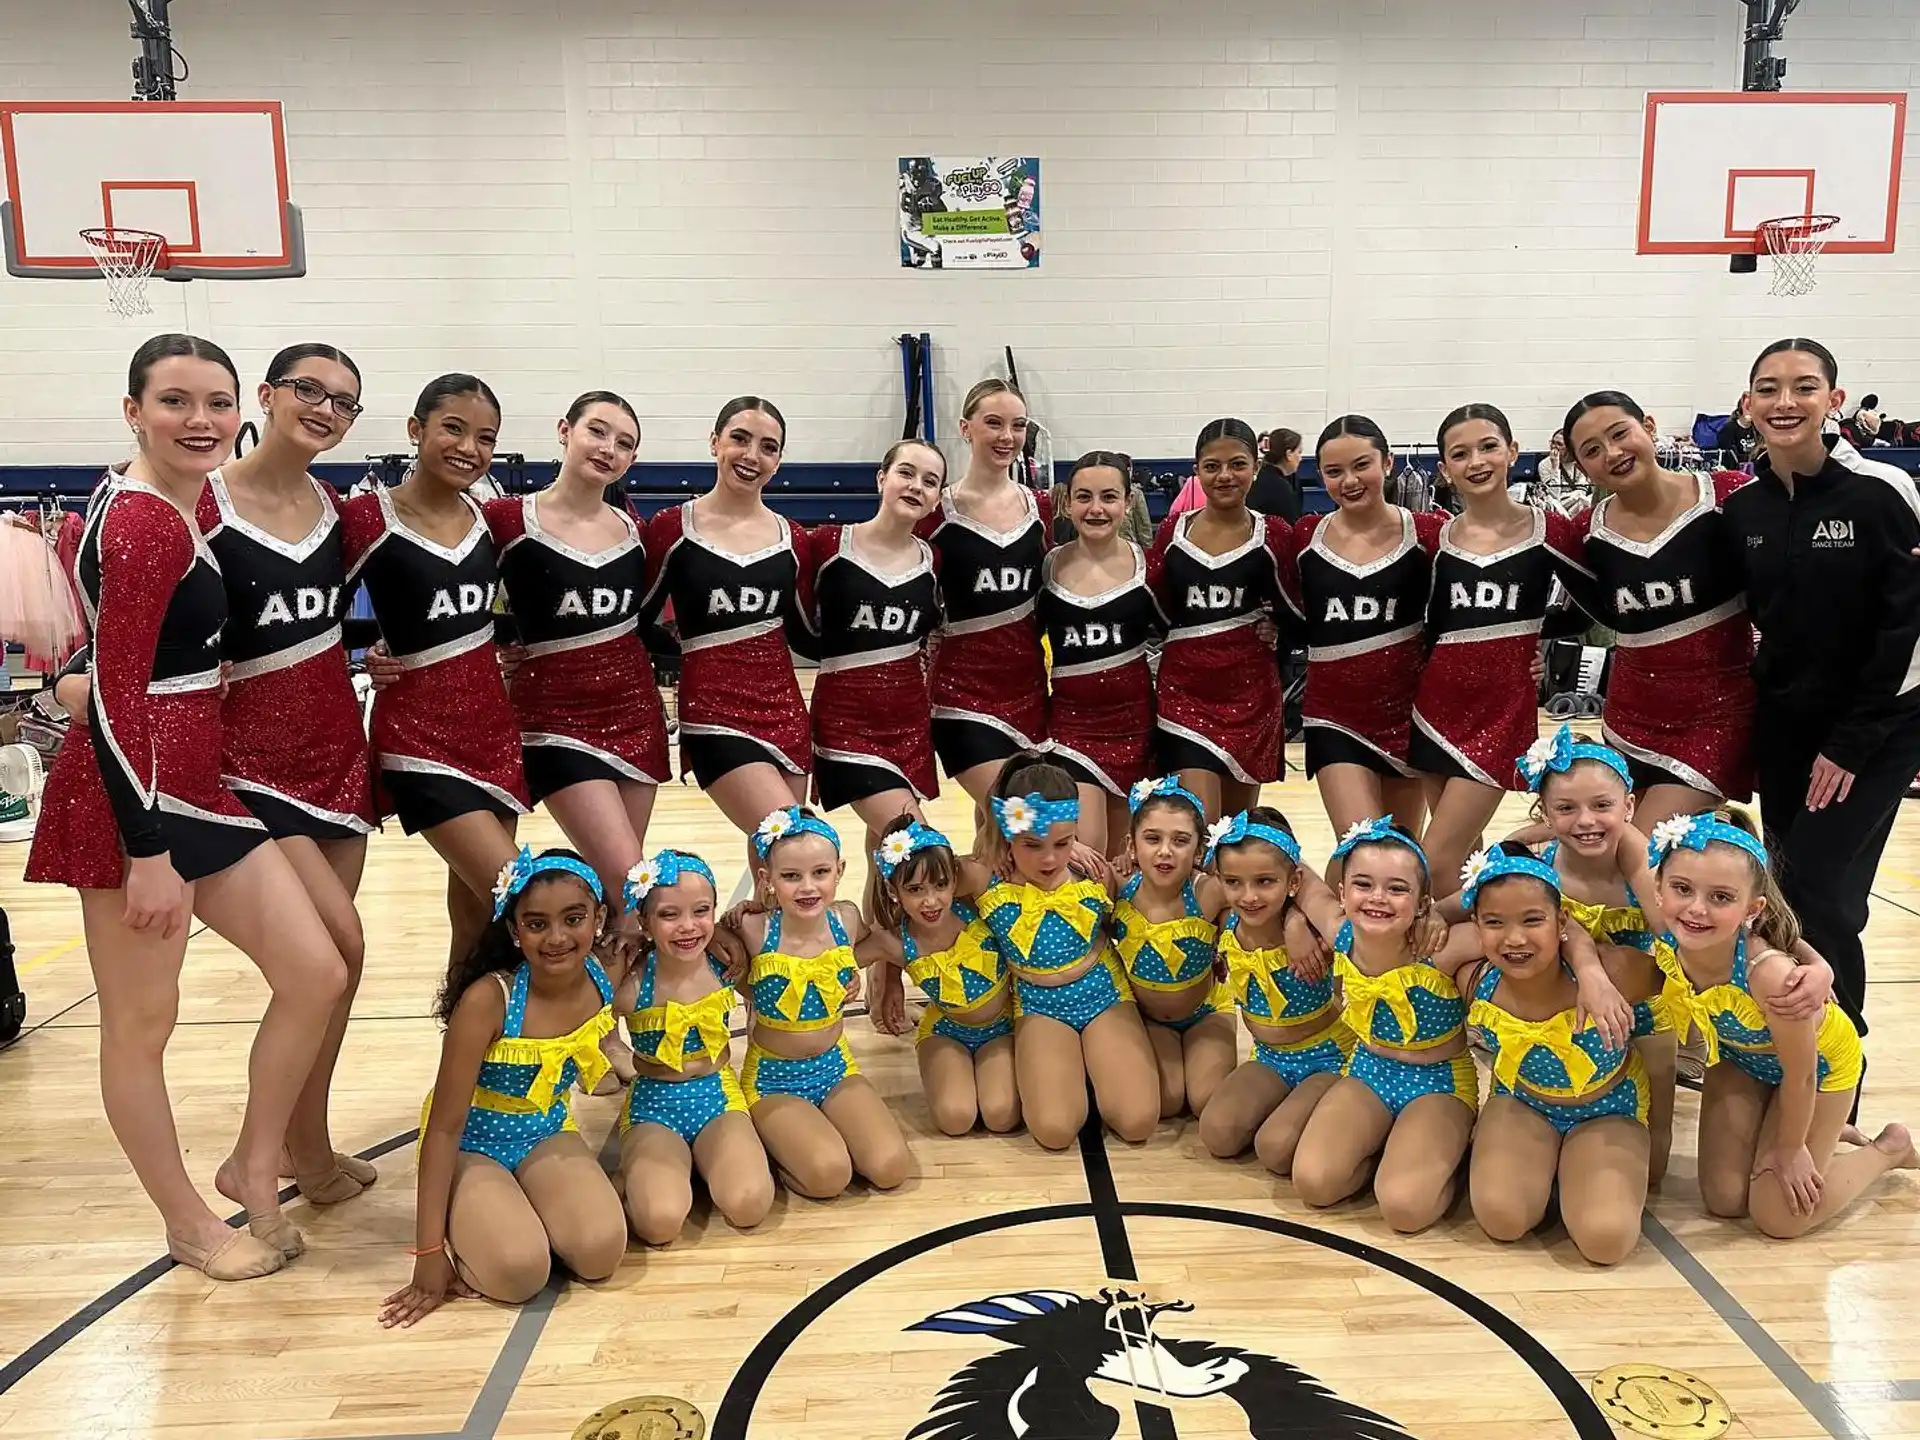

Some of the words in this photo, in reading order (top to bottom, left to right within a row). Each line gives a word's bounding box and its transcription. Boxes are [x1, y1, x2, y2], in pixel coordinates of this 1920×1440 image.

[971, 167, 987, 179] UP
[1812, 520, 1855, 540] ADI
[974, 567, 1031, 592] ADI
[257, 586, 340, 626] ADI
[427, 582, 495, 621] ADI
[556, 587, 633, 617] ADI
[707, 586, 780, 615] ADI
[1187, 585, 1245, 609] ADI
[1324, 595, 1397, 622] ADI
[1450, 581, 1520, 611] ADI
[1617, 579, 1693, 614] ADI
[850, 604, 920, 634] ADI
[1063, 623, 1122, 647] ADI
